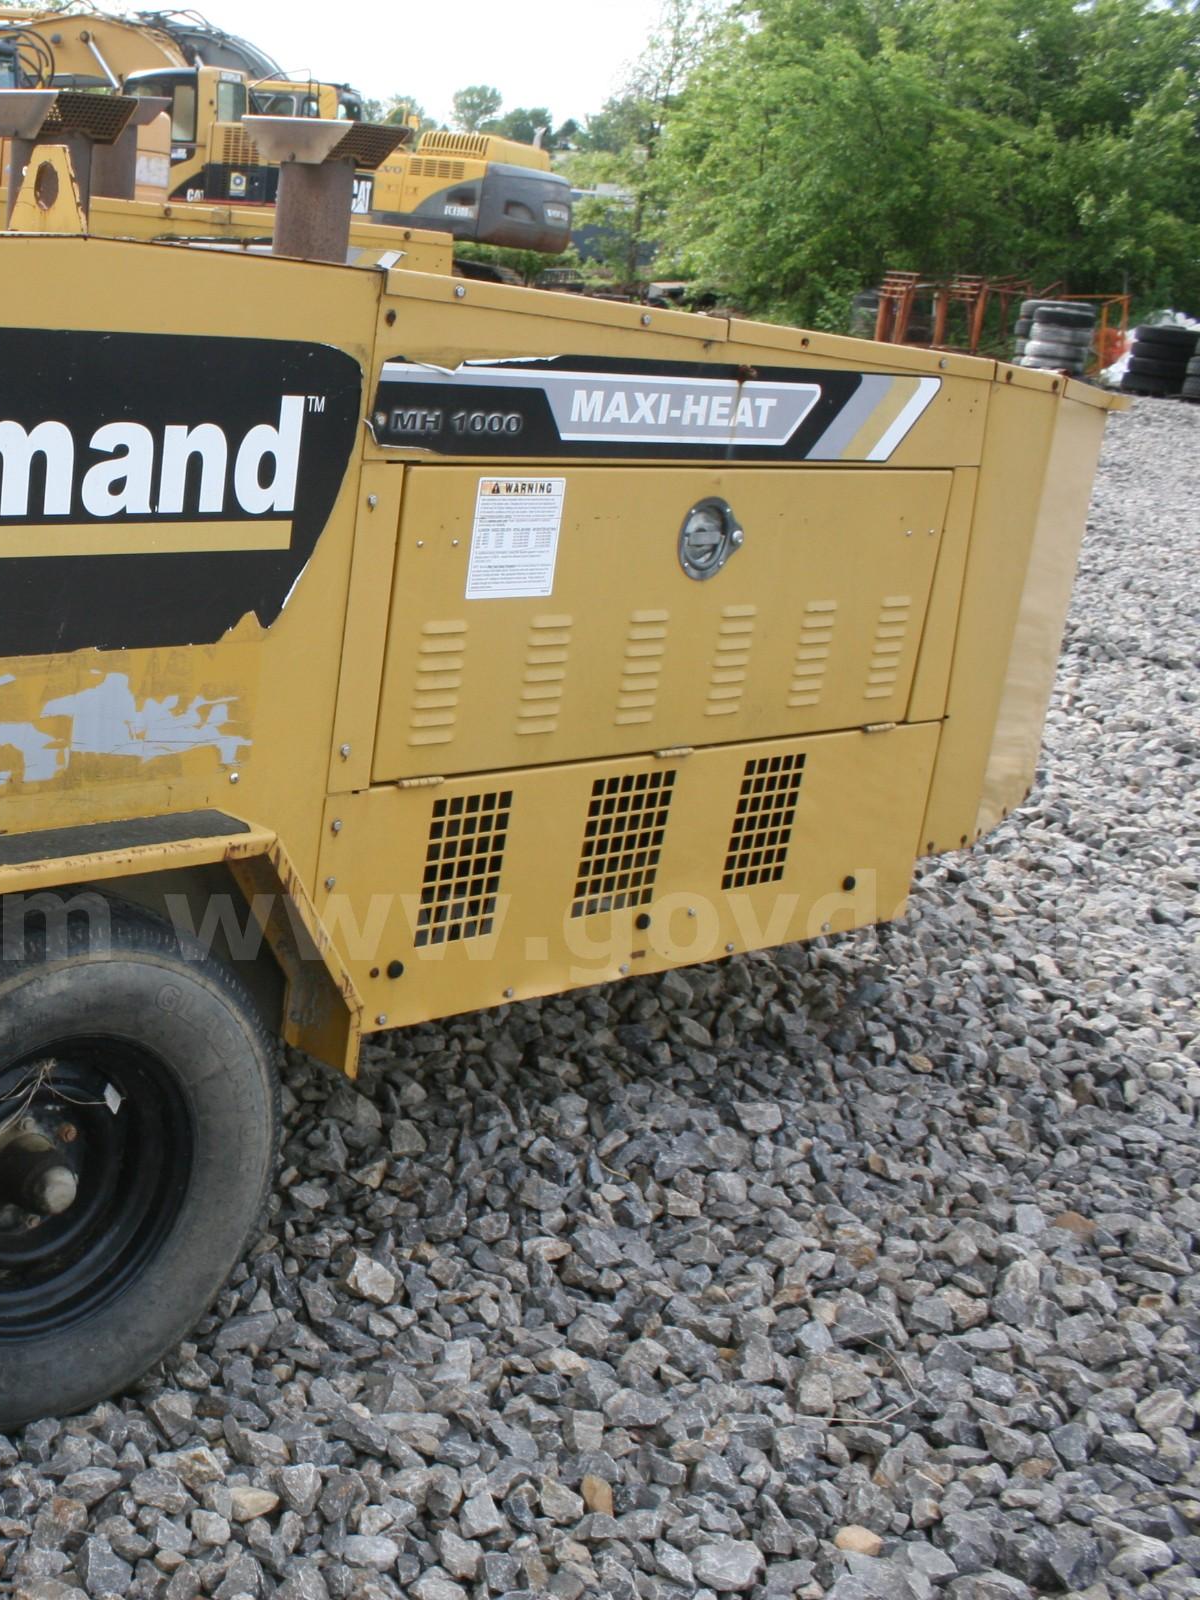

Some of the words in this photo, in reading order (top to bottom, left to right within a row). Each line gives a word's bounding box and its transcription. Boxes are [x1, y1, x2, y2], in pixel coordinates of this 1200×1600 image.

[392, 409, 442, 431] MH
[452, 411, 522, 433] 1000
[569, 389, 777, 429] MAXI-HEAT
[505, 482, 553, 494] WARNING
